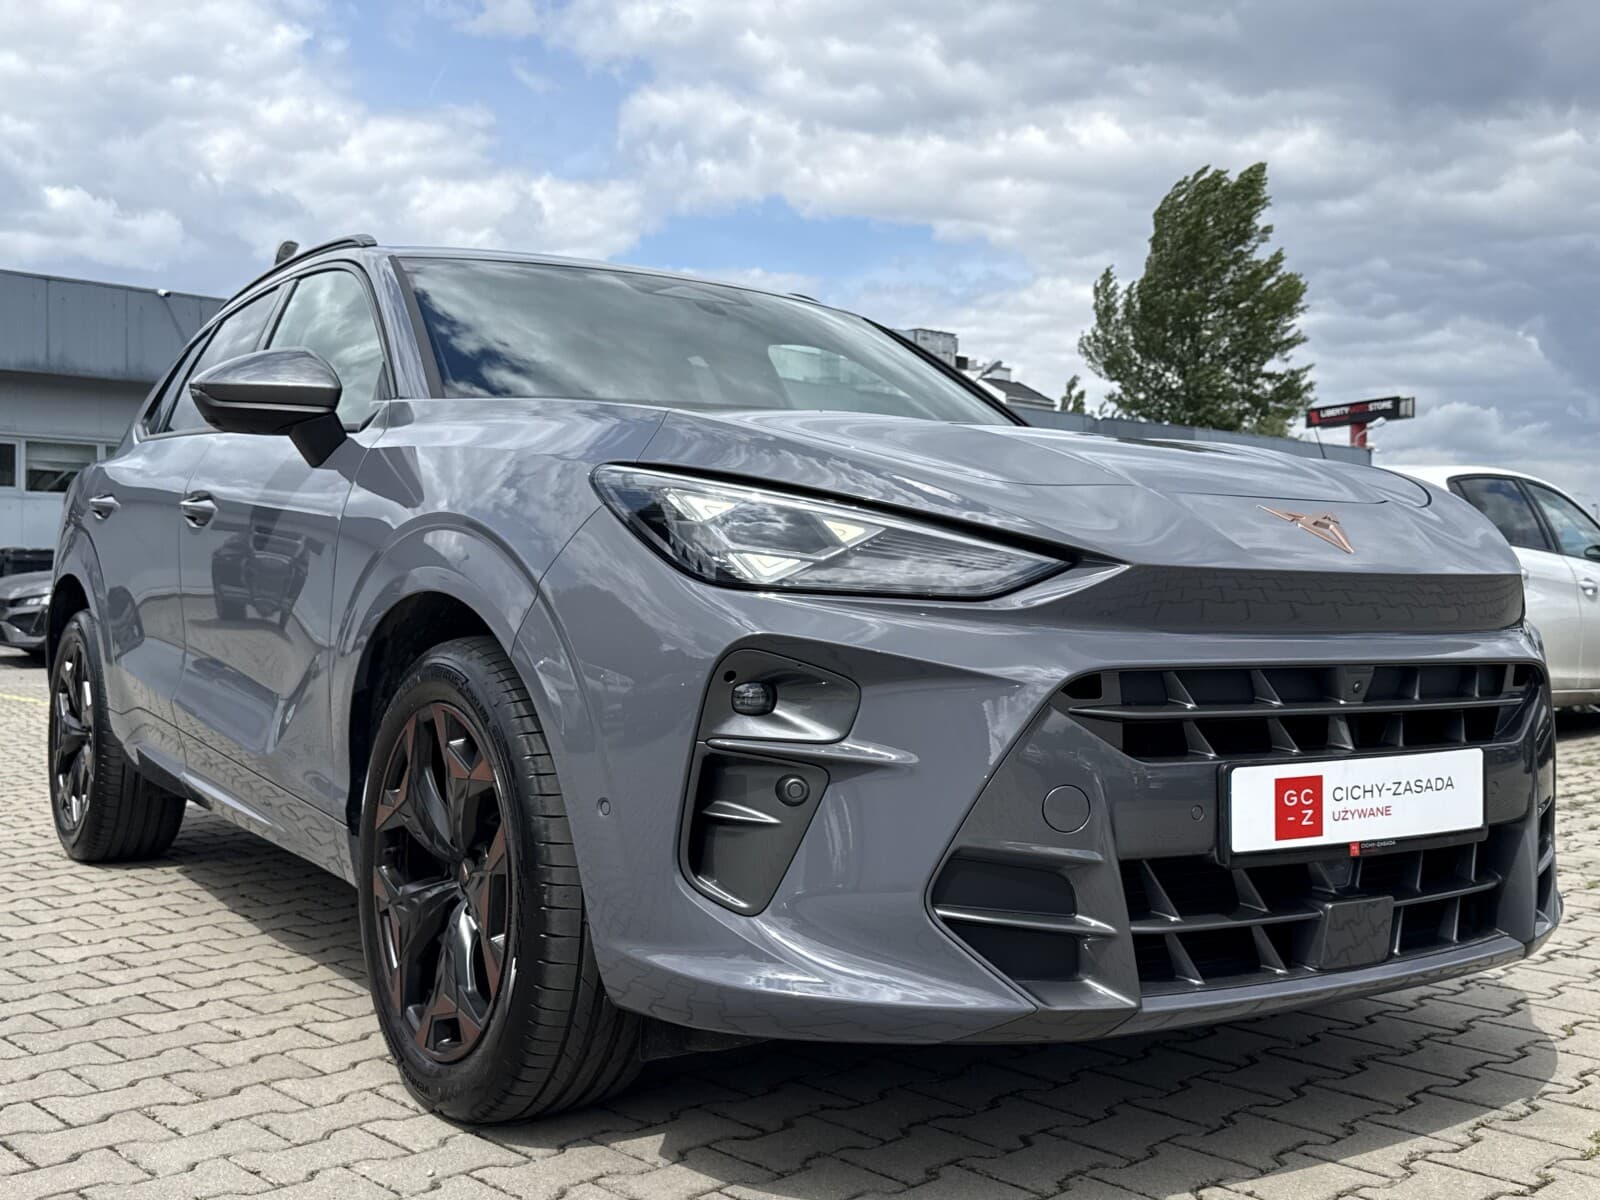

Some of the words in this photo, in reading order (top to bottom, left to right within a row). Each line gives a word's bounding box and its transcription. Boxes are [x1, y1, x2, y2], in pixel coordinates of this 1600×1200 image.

[1283, 788, 1314, 807] GC
[1332, 776, 1455, 802] CICHY-ZASADA
[1332, 805, 1393, 822] UŻYWANE
